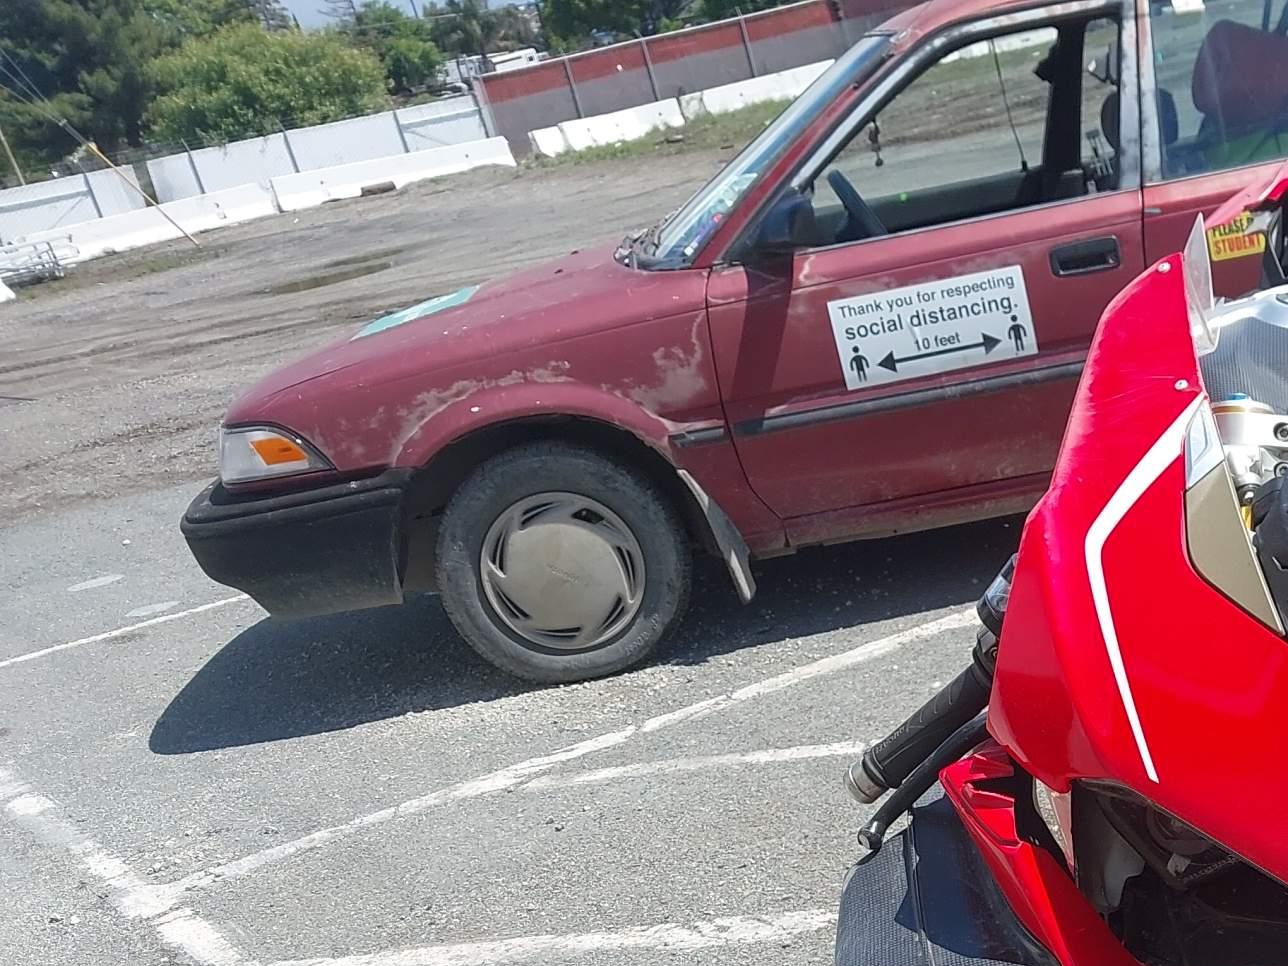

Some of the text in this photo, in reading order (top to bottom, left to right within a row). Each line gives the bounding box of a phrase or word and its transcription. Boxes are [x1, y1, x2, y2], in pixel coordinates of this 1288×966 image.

[1214, 233, 1260, 255] STUDENT
[838, 275, 1015, 319] Thank you for respecting
[844, 296, 1019, 340] social distancing.
[914, 331, 961, 352] 10 feet
